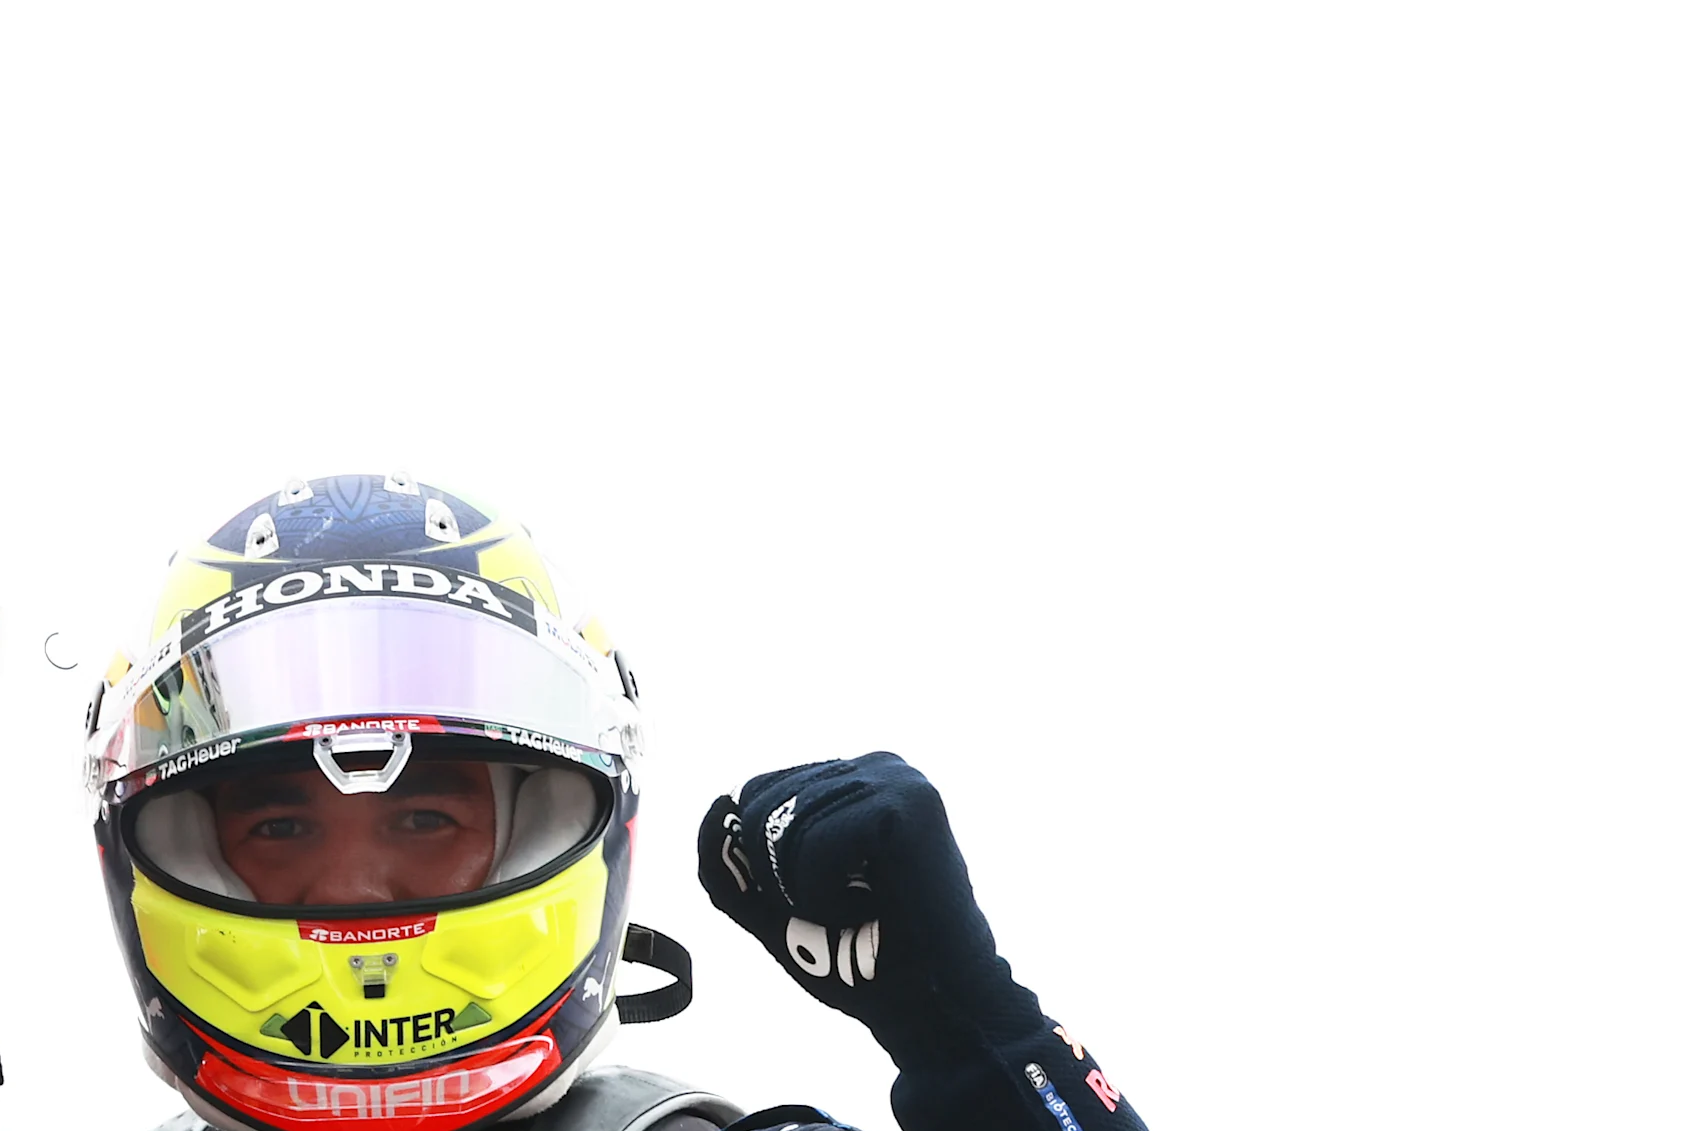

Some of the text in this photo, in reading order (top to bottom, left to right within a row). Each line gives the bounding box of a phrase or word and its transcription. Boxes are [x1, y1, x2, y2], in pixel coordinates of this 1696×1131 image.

[204, 562, 513, 634] HONDA
[322, 719, 421, 735] BANORTE
[329, 922, 426, 942] BANORTE
[354, 1007, 456, 1049] INTER
